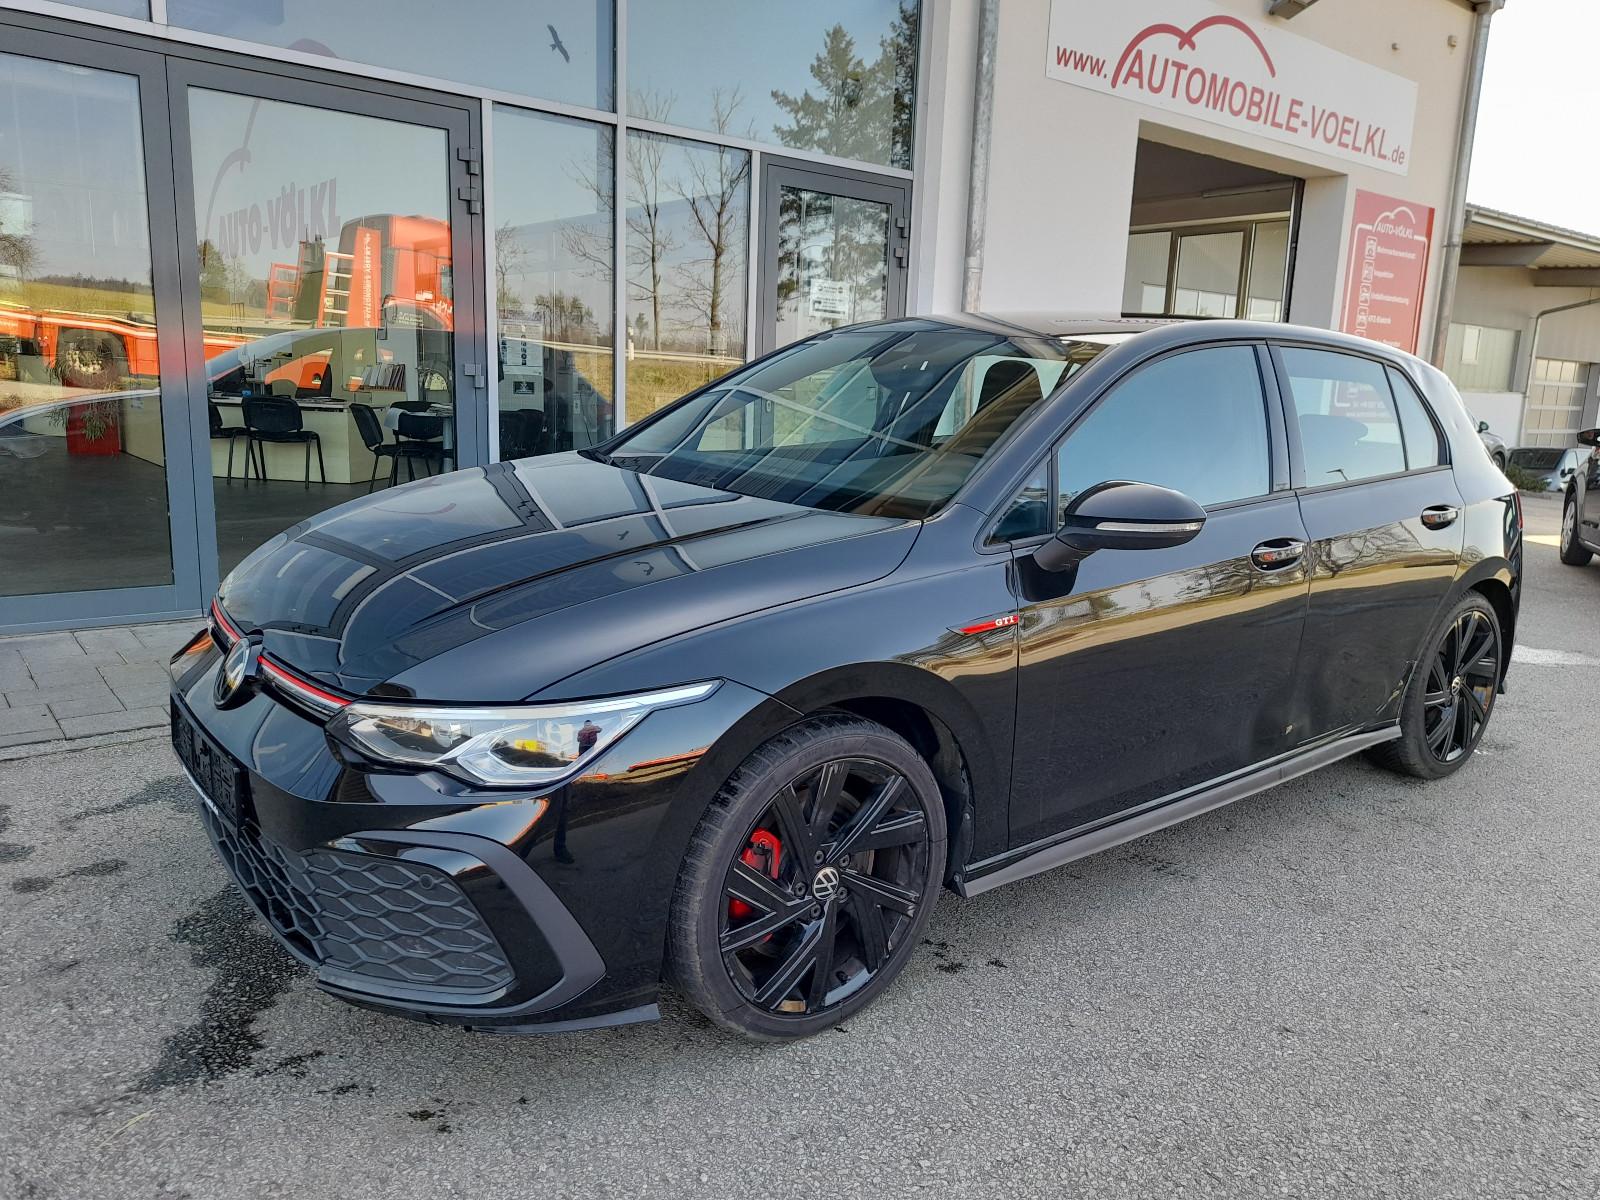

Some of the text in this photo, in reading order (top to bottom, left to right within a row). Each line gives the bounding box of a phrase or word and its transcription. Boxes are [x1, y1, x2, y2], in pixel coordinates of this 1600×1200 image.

[1056, 45, 1107, 79] www.
[218, 177, 341, 260] AUTO-VÖLKL
[995, 615, 1014, 626] GTI
